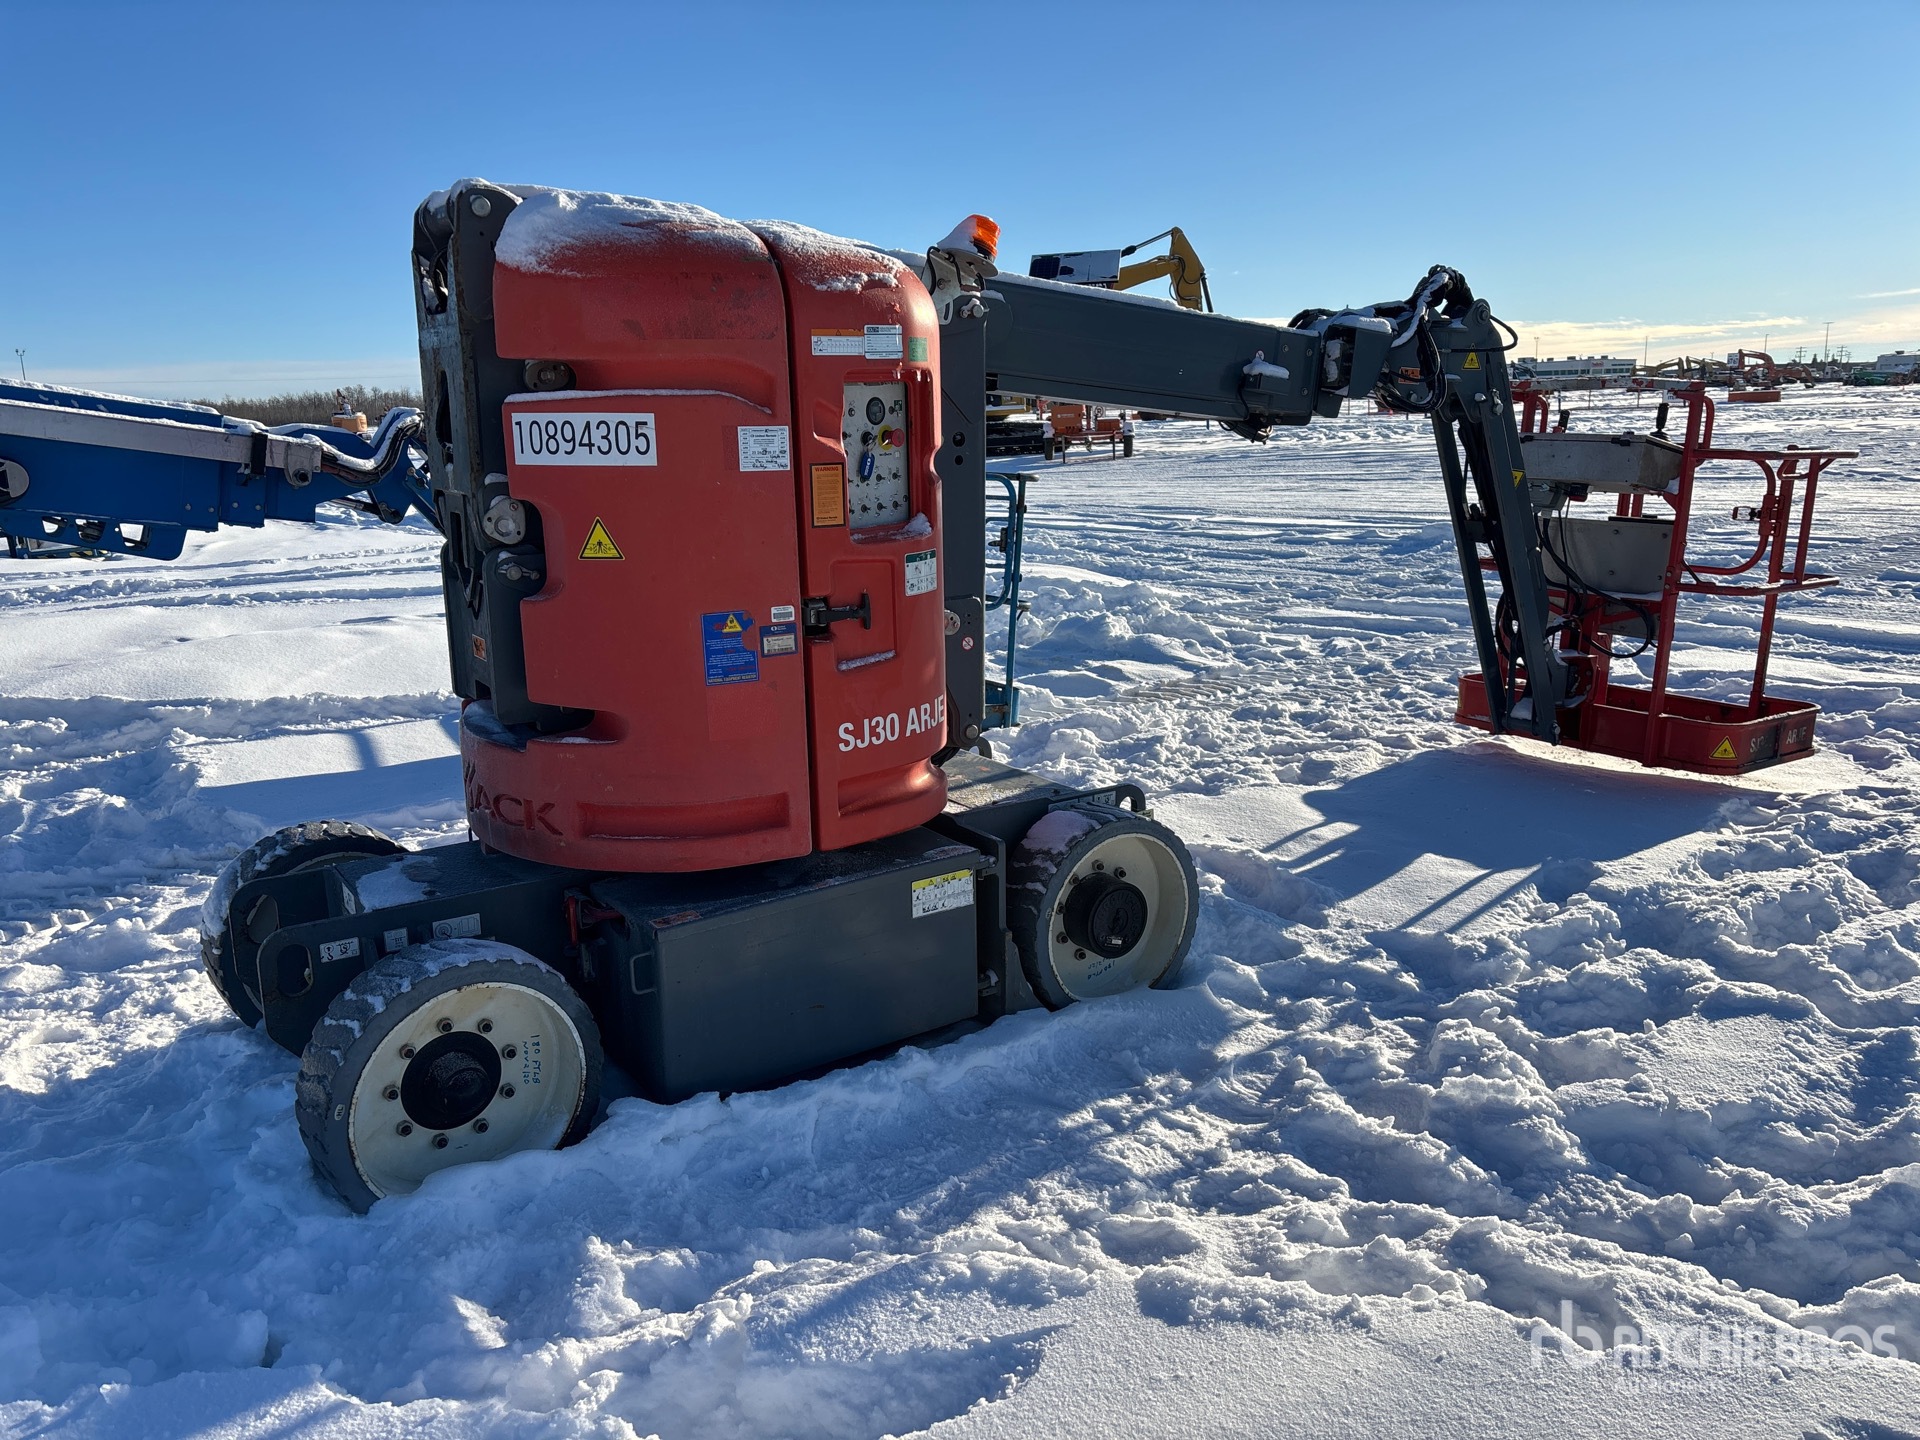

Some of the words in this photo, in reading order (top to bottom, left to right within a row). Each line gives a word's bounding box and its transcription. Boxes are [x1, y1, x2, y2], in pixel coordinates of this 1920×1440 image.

[514, 419, 651, 456] 10894305
[838, 712, 900, 752] SJ30
[905, 694, 945, 738] ARJE
